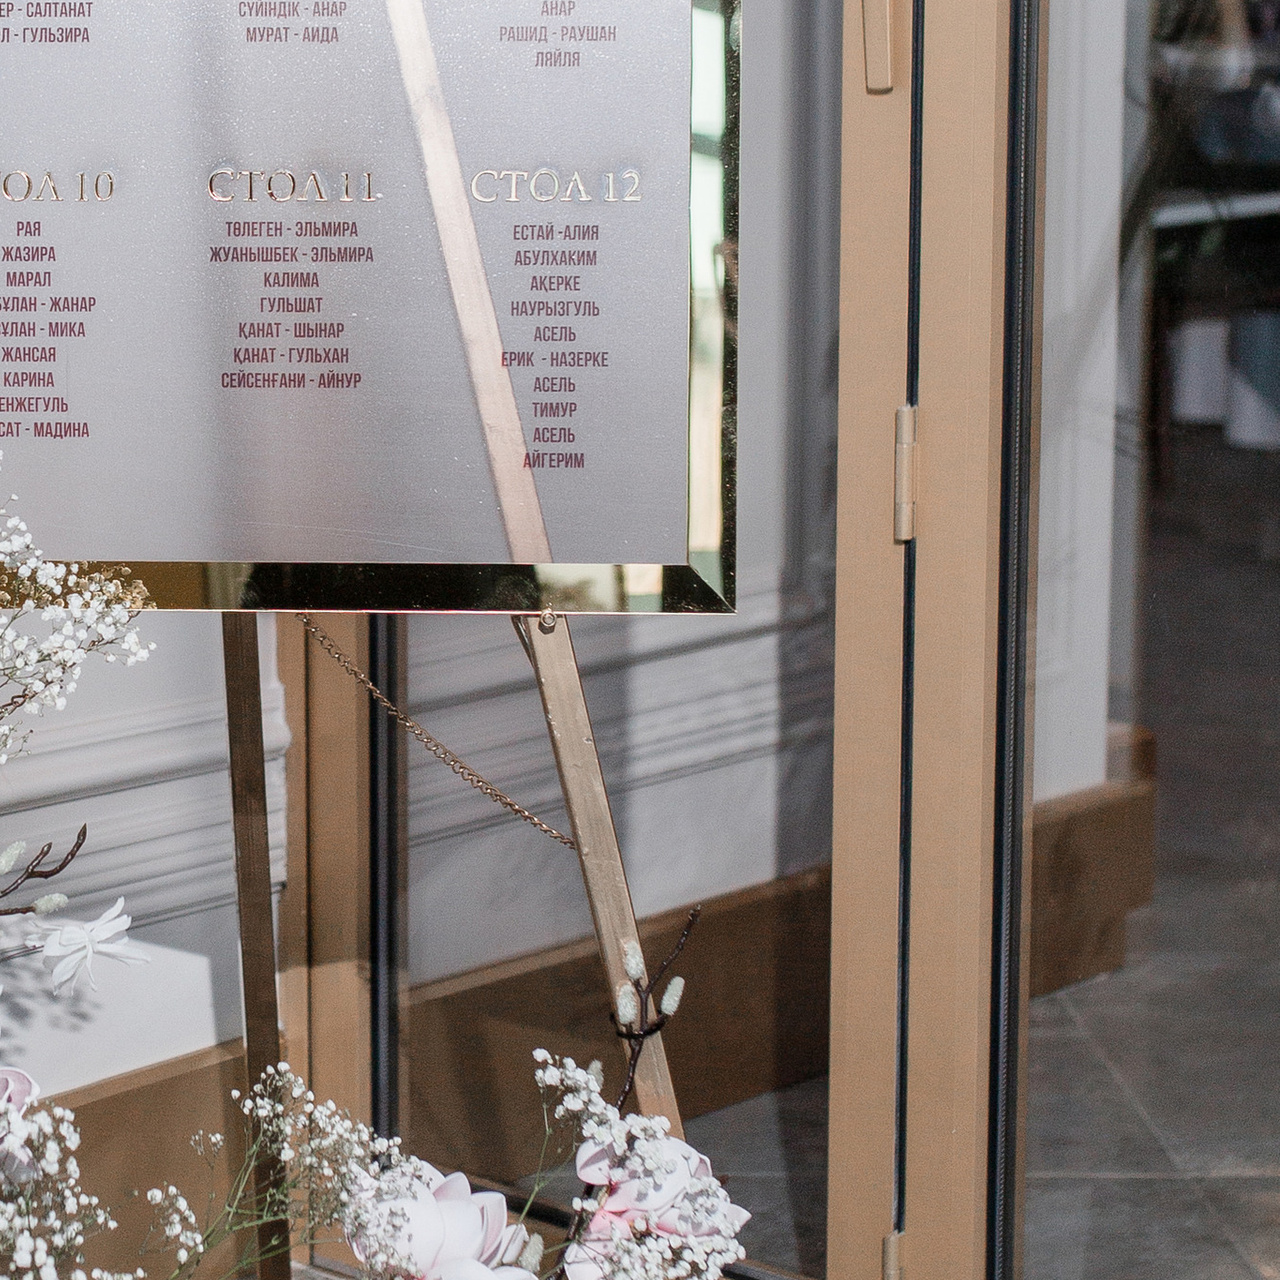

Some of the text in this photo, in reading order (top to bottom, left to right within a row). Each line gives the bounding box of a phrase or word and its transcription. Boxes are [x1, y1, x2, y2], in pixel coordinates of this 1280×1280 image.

[26, 2, 93, 18] САЛТАНАТ
[23, 28, 90, 43] ГУЛЬЗИРА
[75, 170, 115, 203] 10
[208, 168, 376, 202] СТОЛ 11
[470, 170, 644, 202] СТОЛ 12
[16, 221, 41, 237] РАЯ
[295, 222, 358, 237] ЭЛЬМИРА
[513, 222, 554, 241] ЕСТАЙ
[1, 247, 56, 262] ЖАЗИРА
[209, 247, 374, 262] ЖУАНЫШБЕК ЭЛЬМИРА
[515, 250, 597, 266] АБУЛХАКИМ
[6, 272, 51, 287] МАРАЛ
[264, 272, 319, 288] КАЛИМА
[49, 297, 96, 312] ЖАНАР
[260, 297, 323, 313] ГУЛЬШАТ
[511, 301, 600, 316] НАУРЫЗГУЛЬ
[48, 322, 85, 337] МИКА
[294, 323, 344, 337] ШЫНАР
[534, 326, 576, 342] АСЕЛЬ
[1, 347, 56, 362] ЖАНСАЯ
[289, 348, 349, 363] ГУЛЬХАН
[501, 352, 609, 367] ЕРИК НАЗЕРКЕ
[4, 372, 54, 387] КАРИНА
[318, 370, 361, 389] АЙНУР
[533, 377, 576, 393] АСЕЛЬ
[532, 402, 577, 418] ТИМУР
[34, 422, 89, 439] МАДИНА
[533, 427, 575, 443] АСЕЛЬ
[524, 450, 584, 468] АЙГЕРИМ
